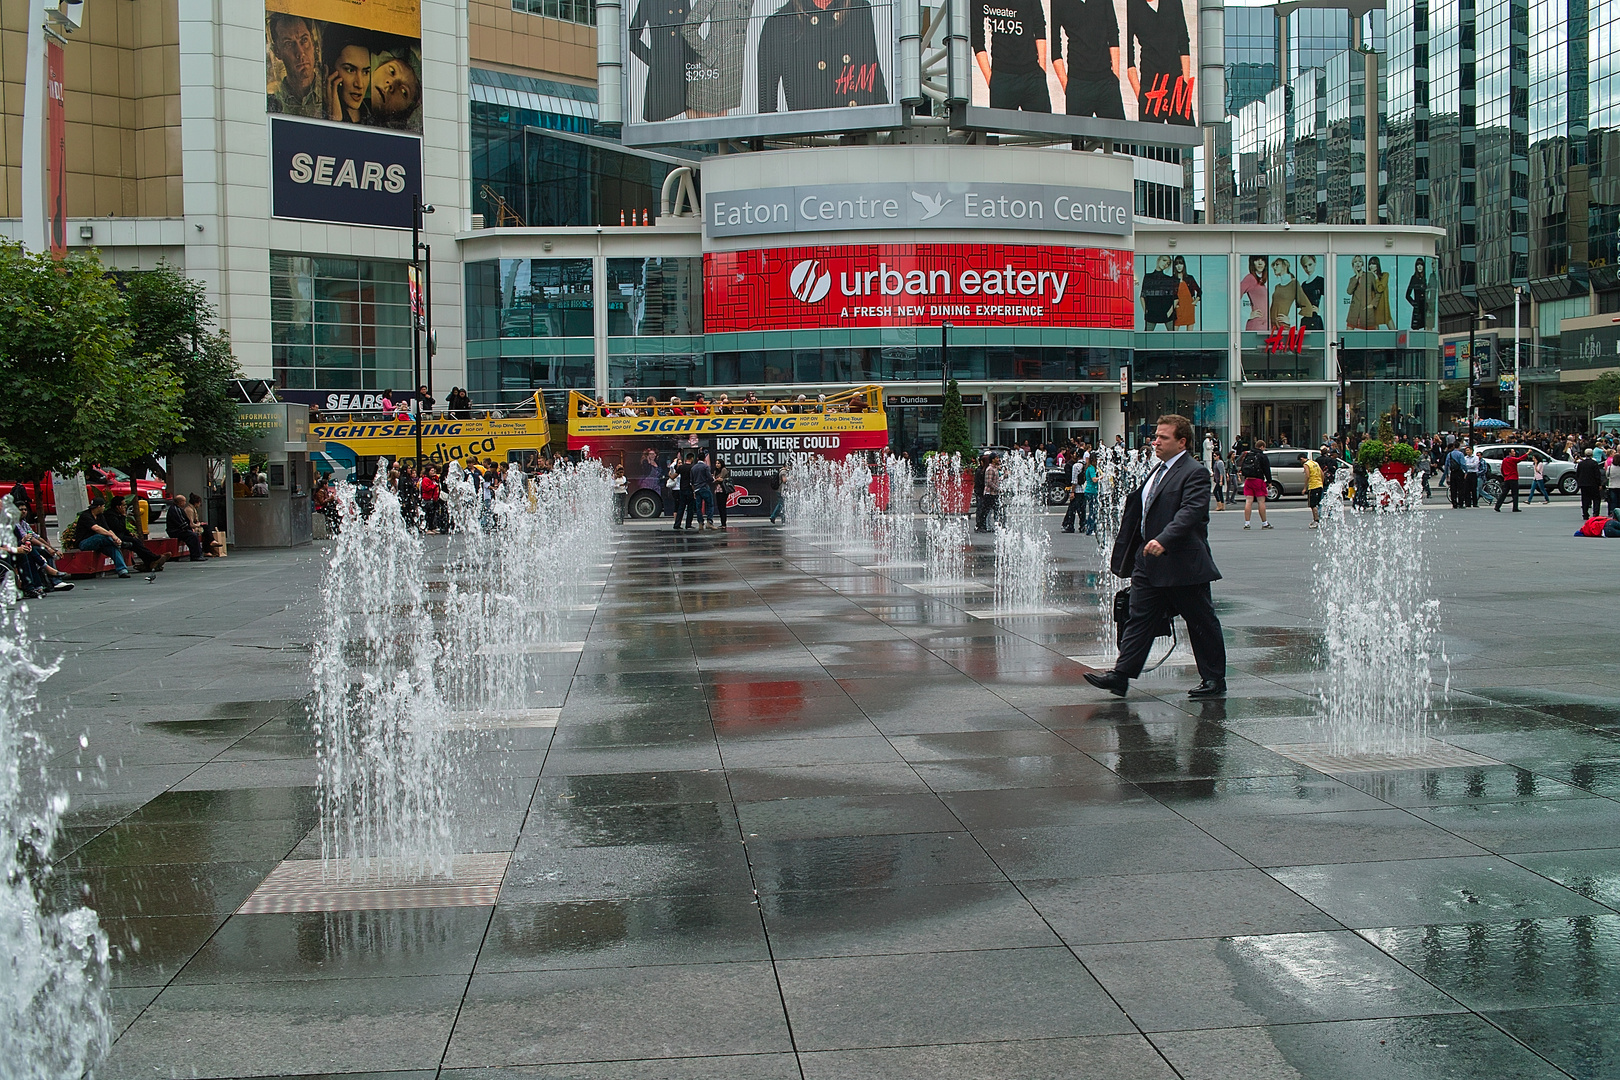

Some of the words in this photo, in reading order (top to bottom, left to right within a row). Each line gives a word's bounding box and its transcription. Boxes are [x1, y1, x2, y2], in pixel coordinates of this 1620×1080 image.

[982, 4, 1018, 19] Sweater
[983, 16, 1023, 36] $14.95
[685, 62, 702, 71] Coat
[685, 69, 720, 82] $29.95
[835, 62, 877, 95] H&M
[1144, 72, 1195, 120] H&M
[289, 152, 406, 194] SEARS
[714, 201, 789, 227] Eaton
[800, 195, 899, 221] Centre
[964, 193, 1044, 219] Eaton
[1054, 195, 1127, 225] Centre
[840, 262, 944, 296] urban
[959, 263, 1069, 304] eatery
[840, 307, 849, 317] A
[853, 306, 892, 317] FRESH
[897, 305, 925, 316] NEW
[930, 305, 971, 316] DINING
[976, 305, 1044, 317] EXPERIENCE
[1264, 325, 1306, 354] H&M
[326, 393, 384, 410] SEARS
[900, 396, 928, 404] Dundas
[1028, 395, 1082, 410] SEARS
[313, 423, 464, 438] SIGHTSEEING
[633, 417, 797, 433] SIGHTSEEING
[716, 437, 741, 450] HOP
[742, 437, 760, 451] ON,
[764, 437, 800, 449] THERE
[803, 436, 841, 449] COULD
[734, 452, 775, 465] CUTIES
[730, 469, 753, 477] hooked
[754, 470, 762, 478] up
